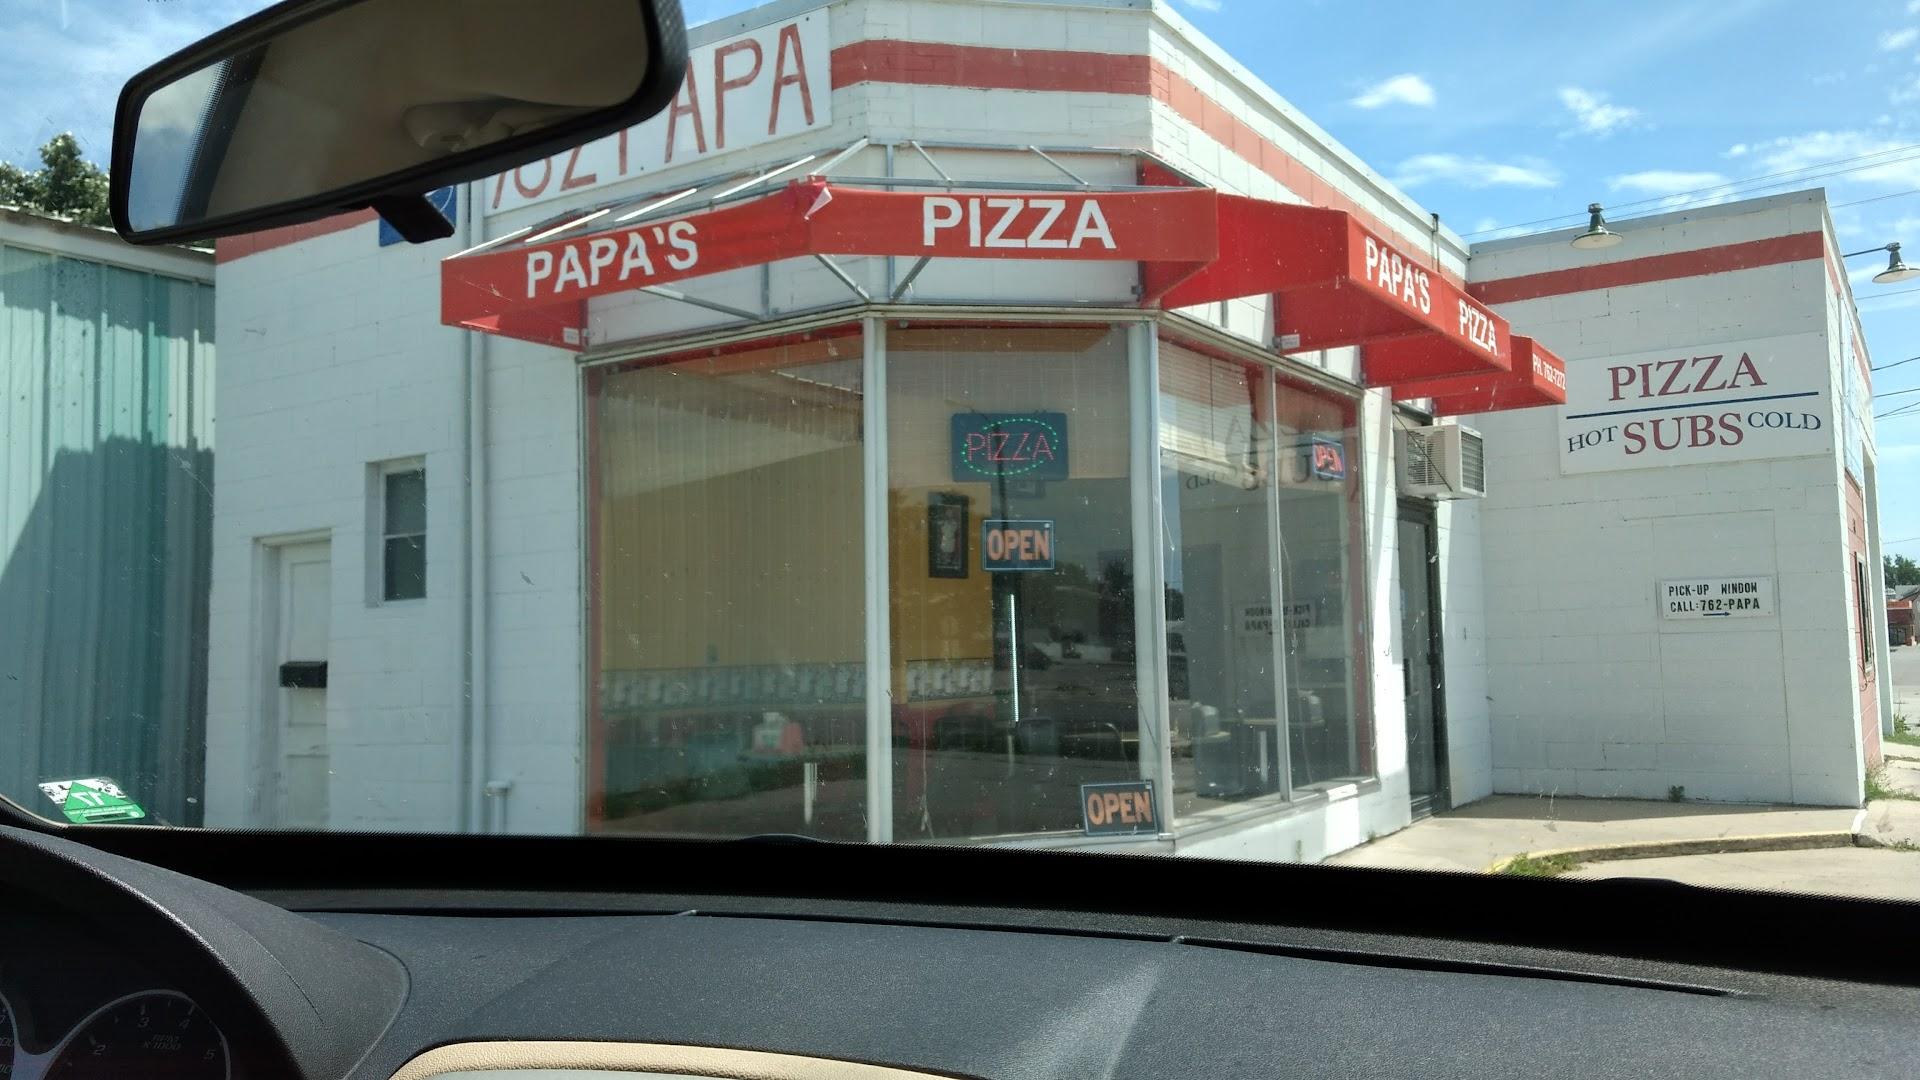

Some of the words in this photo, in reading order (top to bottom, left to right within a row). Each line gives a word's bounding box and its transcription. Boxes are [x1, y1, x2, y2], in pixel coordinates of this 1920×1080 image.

[922, 196, 1117, 249] PIZZA
[526, 219, 699, 299] PAPA'S
[1364, 236, 1431, 315] PAPA'S
[1458, 298, 1498, 357] PIZZA
[1607, 352, 1767, 401] PIZZA
[966, 432, 1055, 461] PIZZA
[1567, 425, 1619, 453] HOT
[1623, 412, 1744, 455] SUBS
[1748, 411, 1822, 431] COLD
[987, 529, 1050, 561] OPEN
[1668, 584, 1710, 597] PICK-UP
[1087, 791, 1153, 826] OPEN
